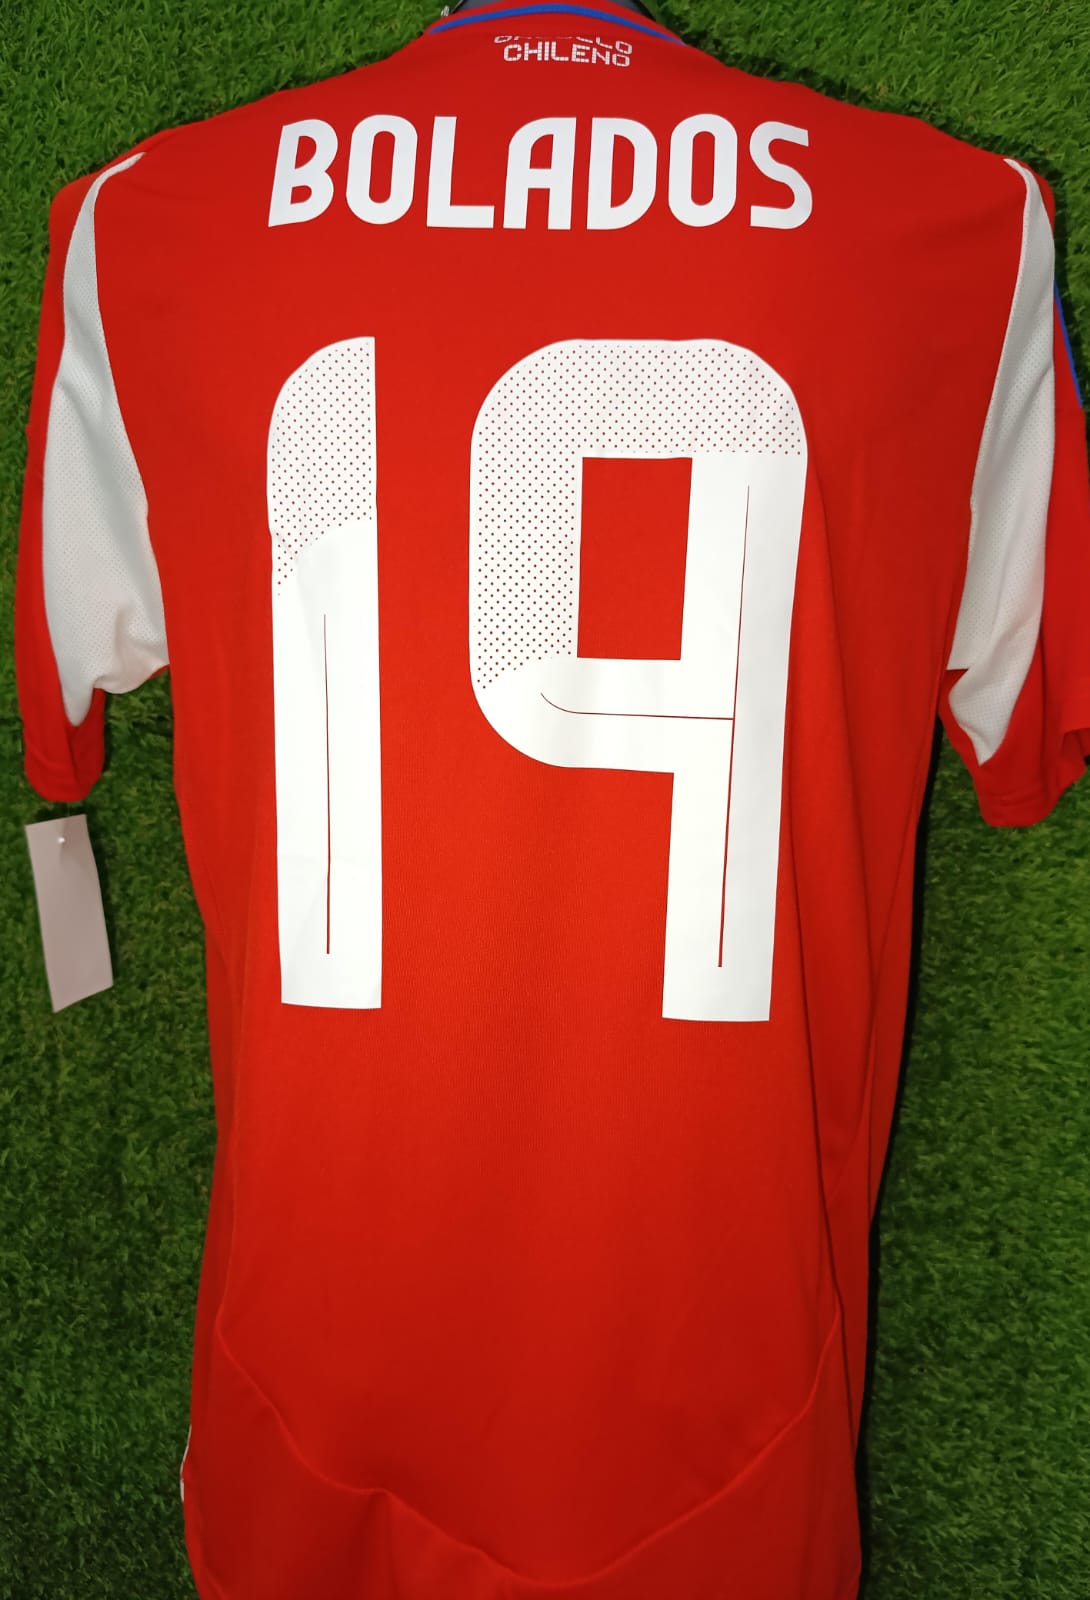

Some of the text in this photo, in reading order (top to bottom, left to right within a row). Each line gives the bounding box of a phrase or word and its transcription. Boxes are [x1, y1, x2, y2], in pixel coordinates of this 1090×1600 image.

[503, 41, 630, 67] CHILENO
[268, 114, 812, 229] BOLADOS
[267, 336, 808, 1022] 19
